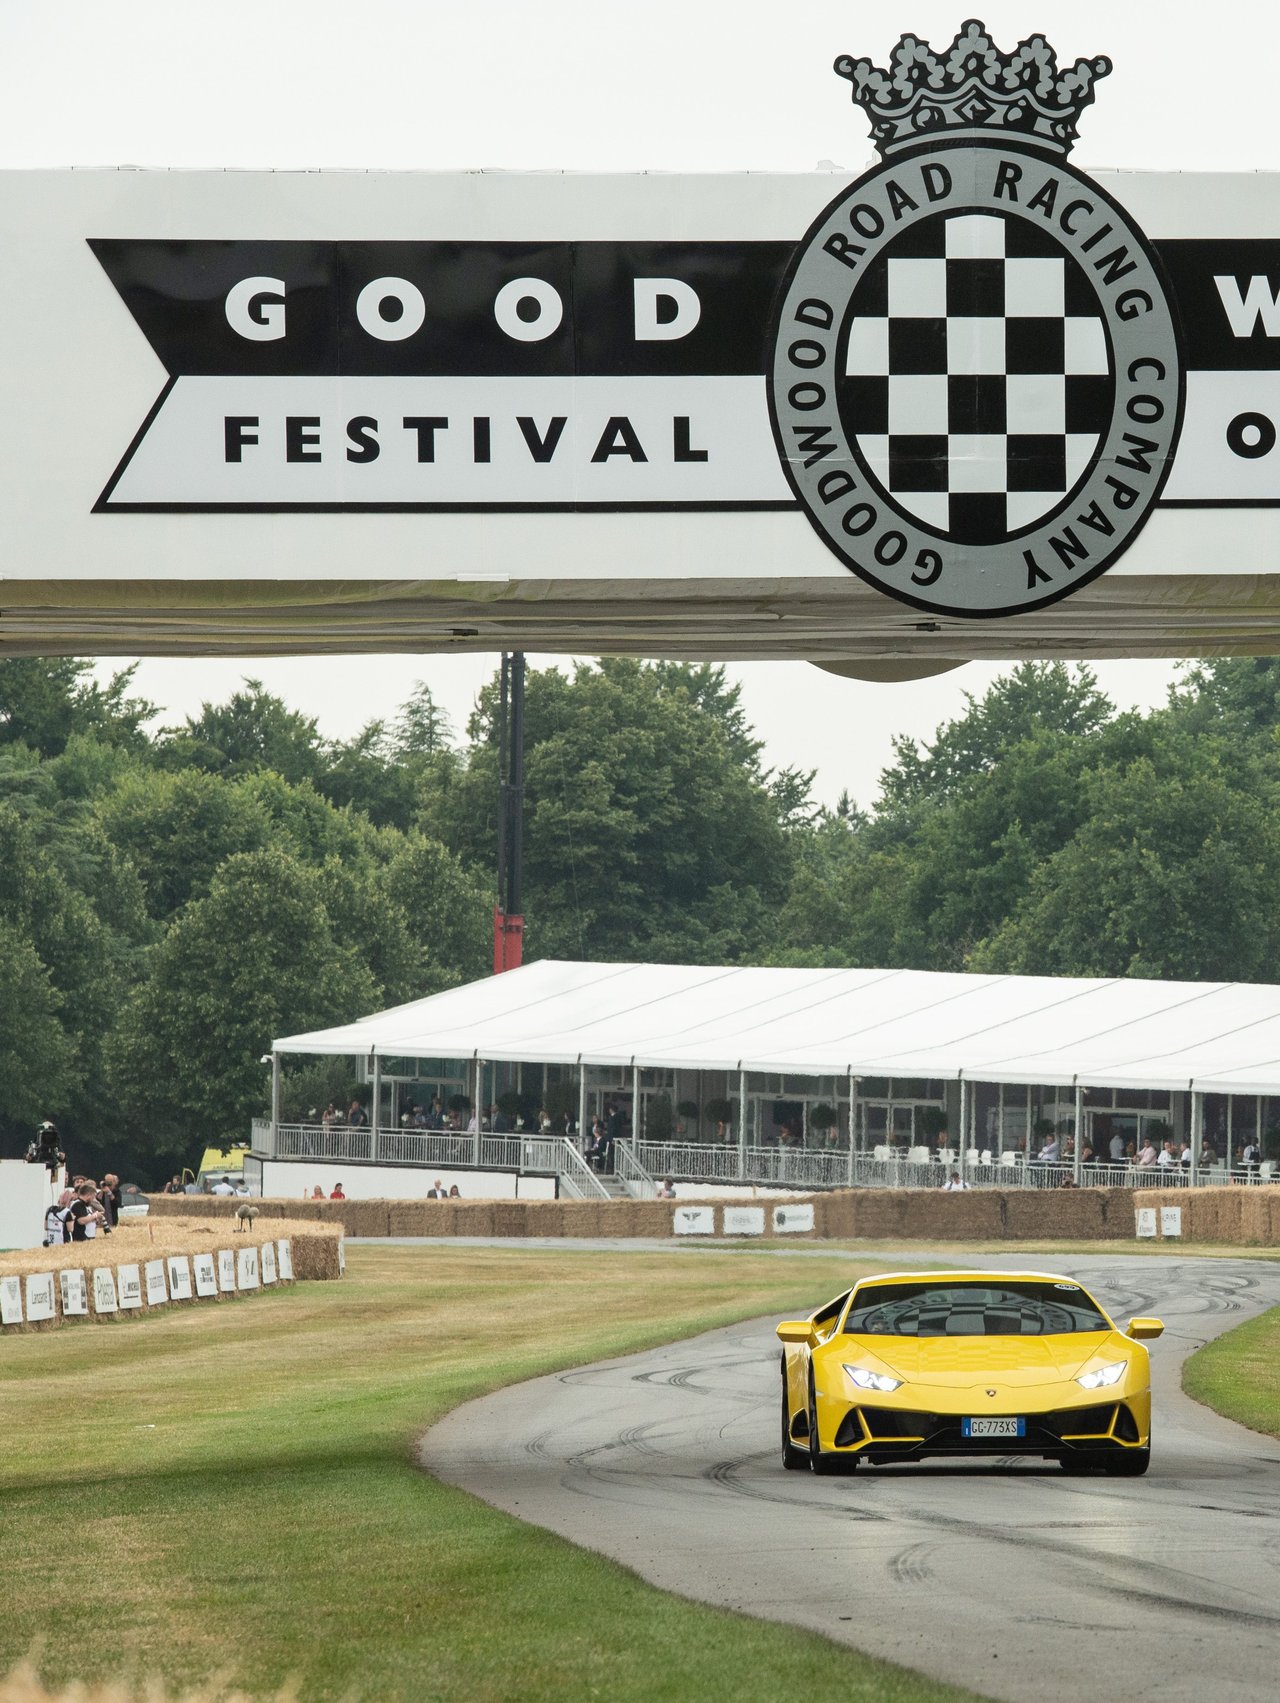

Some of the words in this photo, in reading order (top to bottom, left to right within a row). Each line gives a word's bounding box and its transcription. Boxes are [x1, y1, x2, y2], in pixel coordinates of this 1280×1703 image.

[822, 162, 953, 269] ROAD
[993, 160, 1154, 322] RACING
[225, 276, 700, 341] GOOD
[224, 416, 708, 463] FESTIVAL
[787, 297, 943, 587] GOODWOOD
[1027, 357, 1166, 589] COMPANY
